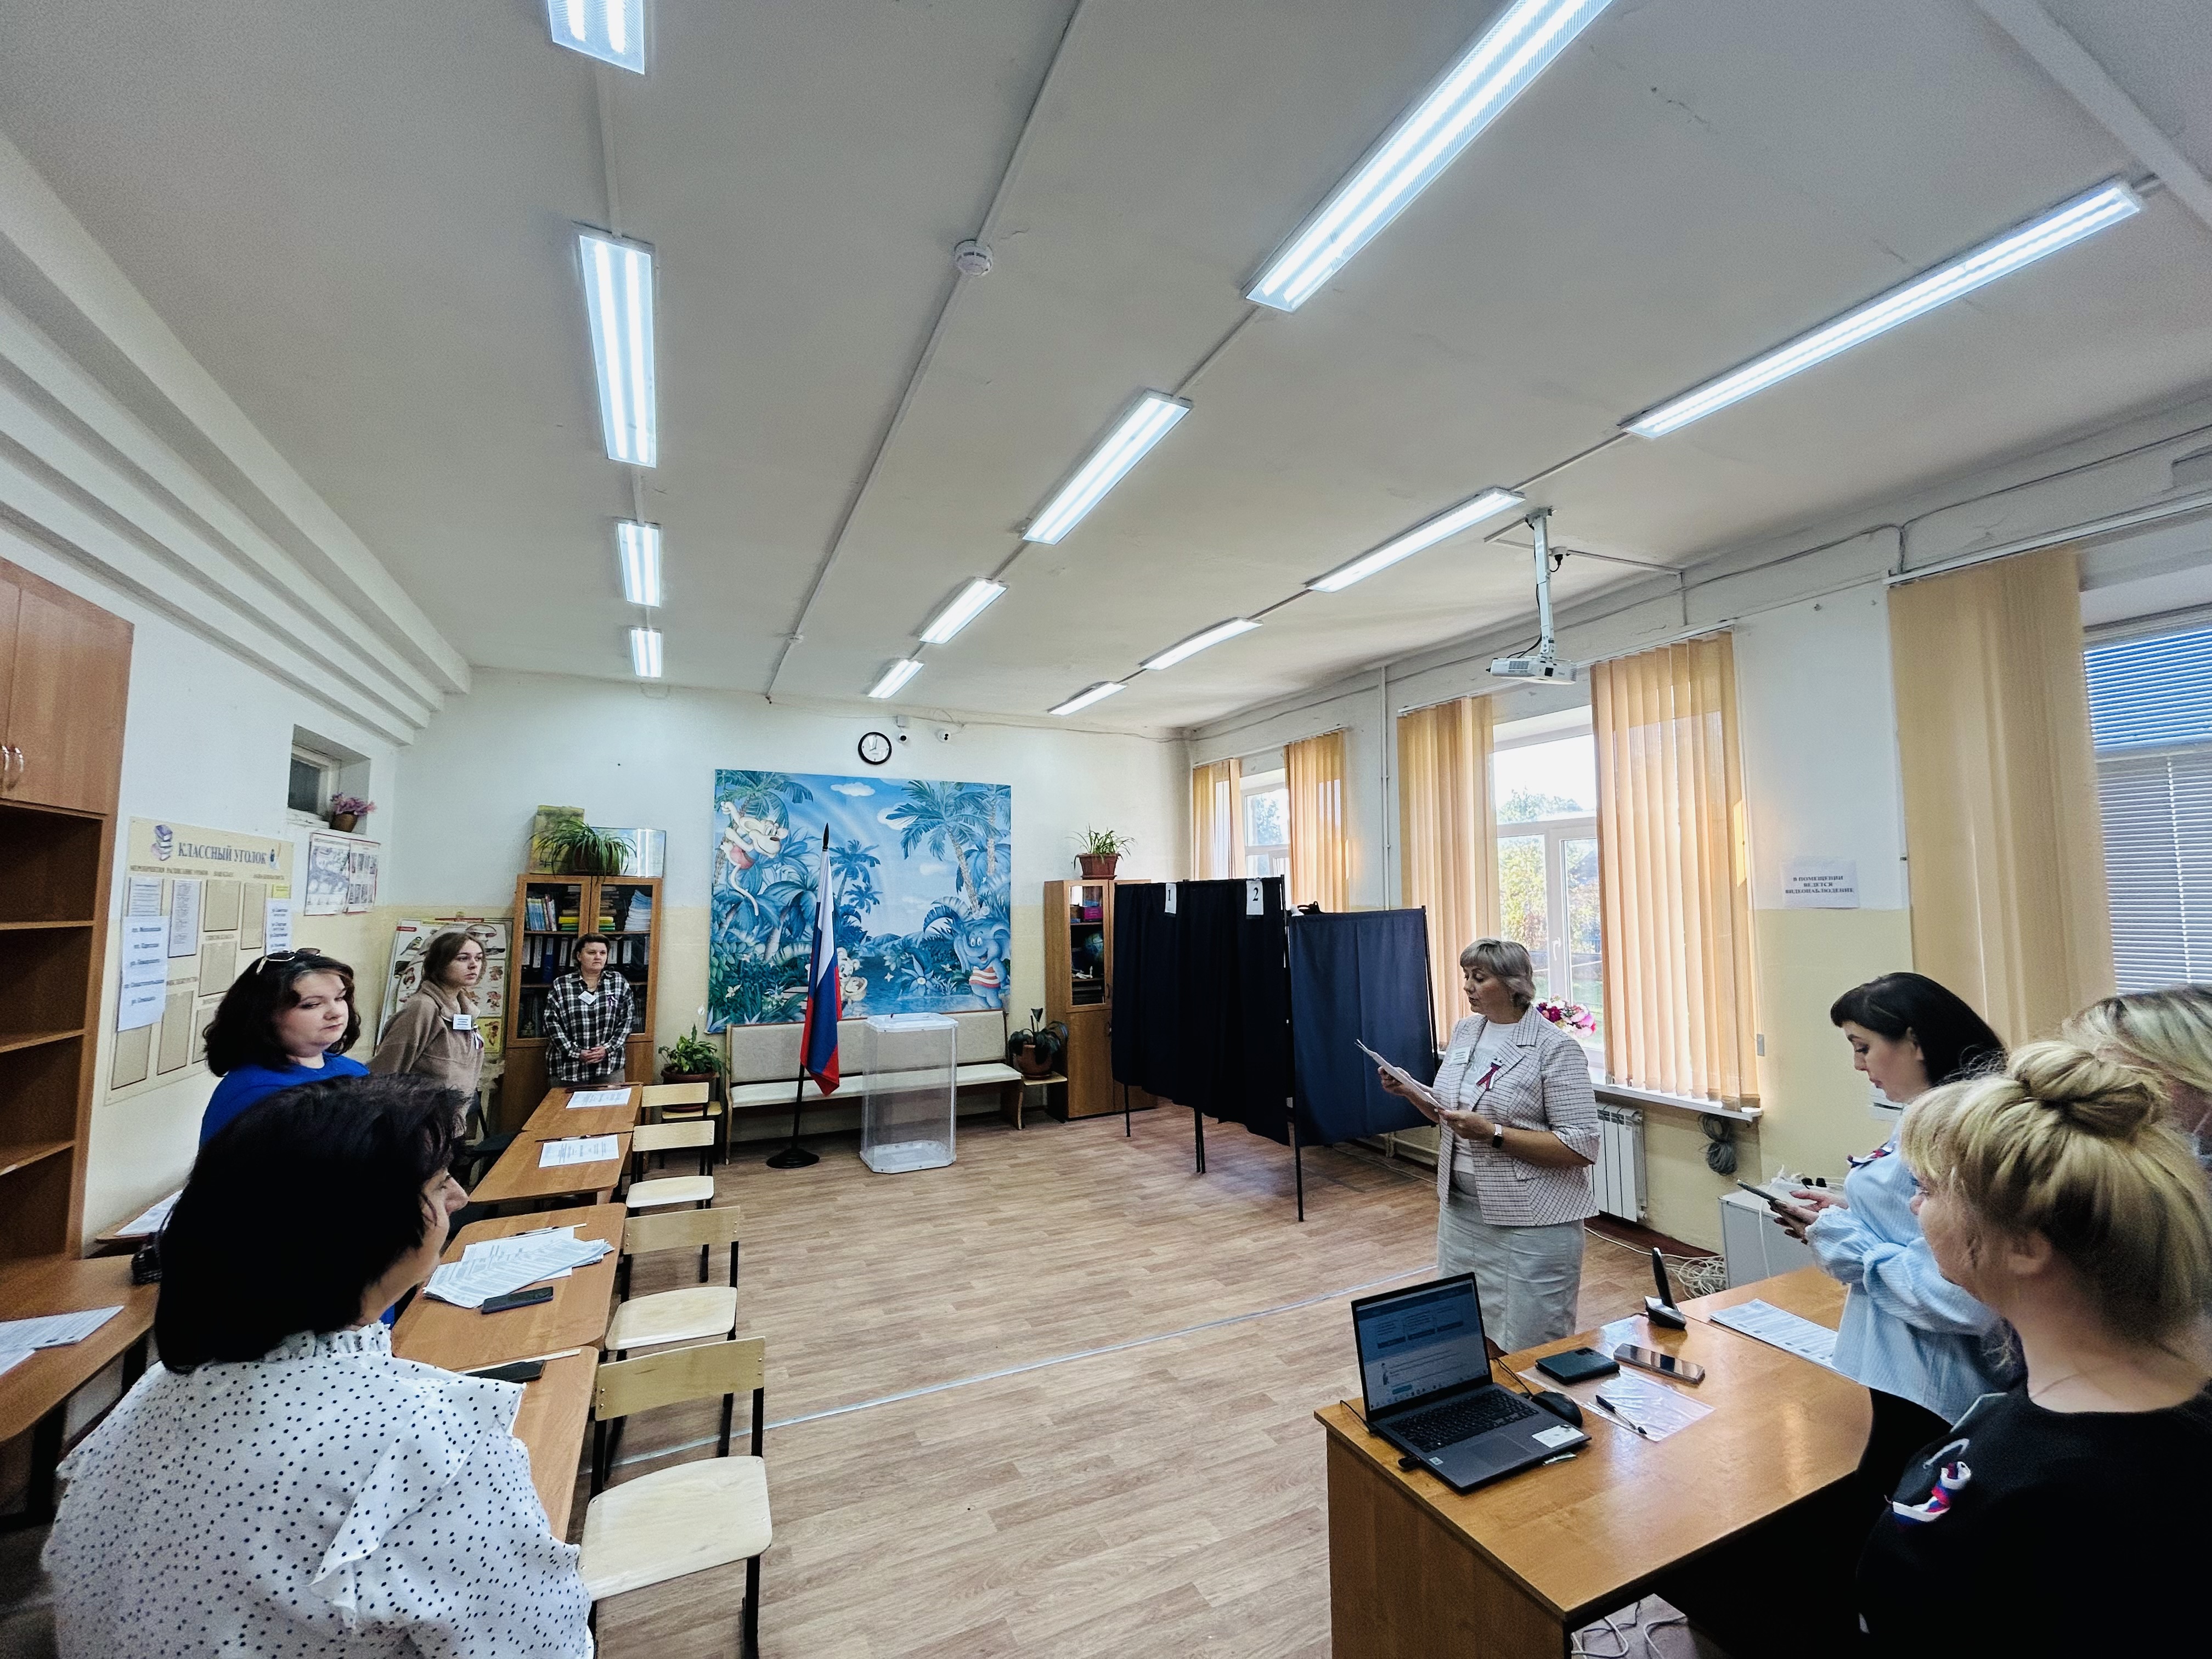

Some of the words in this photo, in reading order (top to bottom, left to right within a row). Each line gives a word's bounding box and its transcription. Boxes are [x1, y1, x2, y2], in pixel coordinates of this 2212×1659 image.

[178, 842, 232, 862] КЛАССНЫЙ
[233, 849, 267, 864] УГОЛОК
[1167, 889, 1171, 901] 1
[1252, 887, 1259, 901] 2
